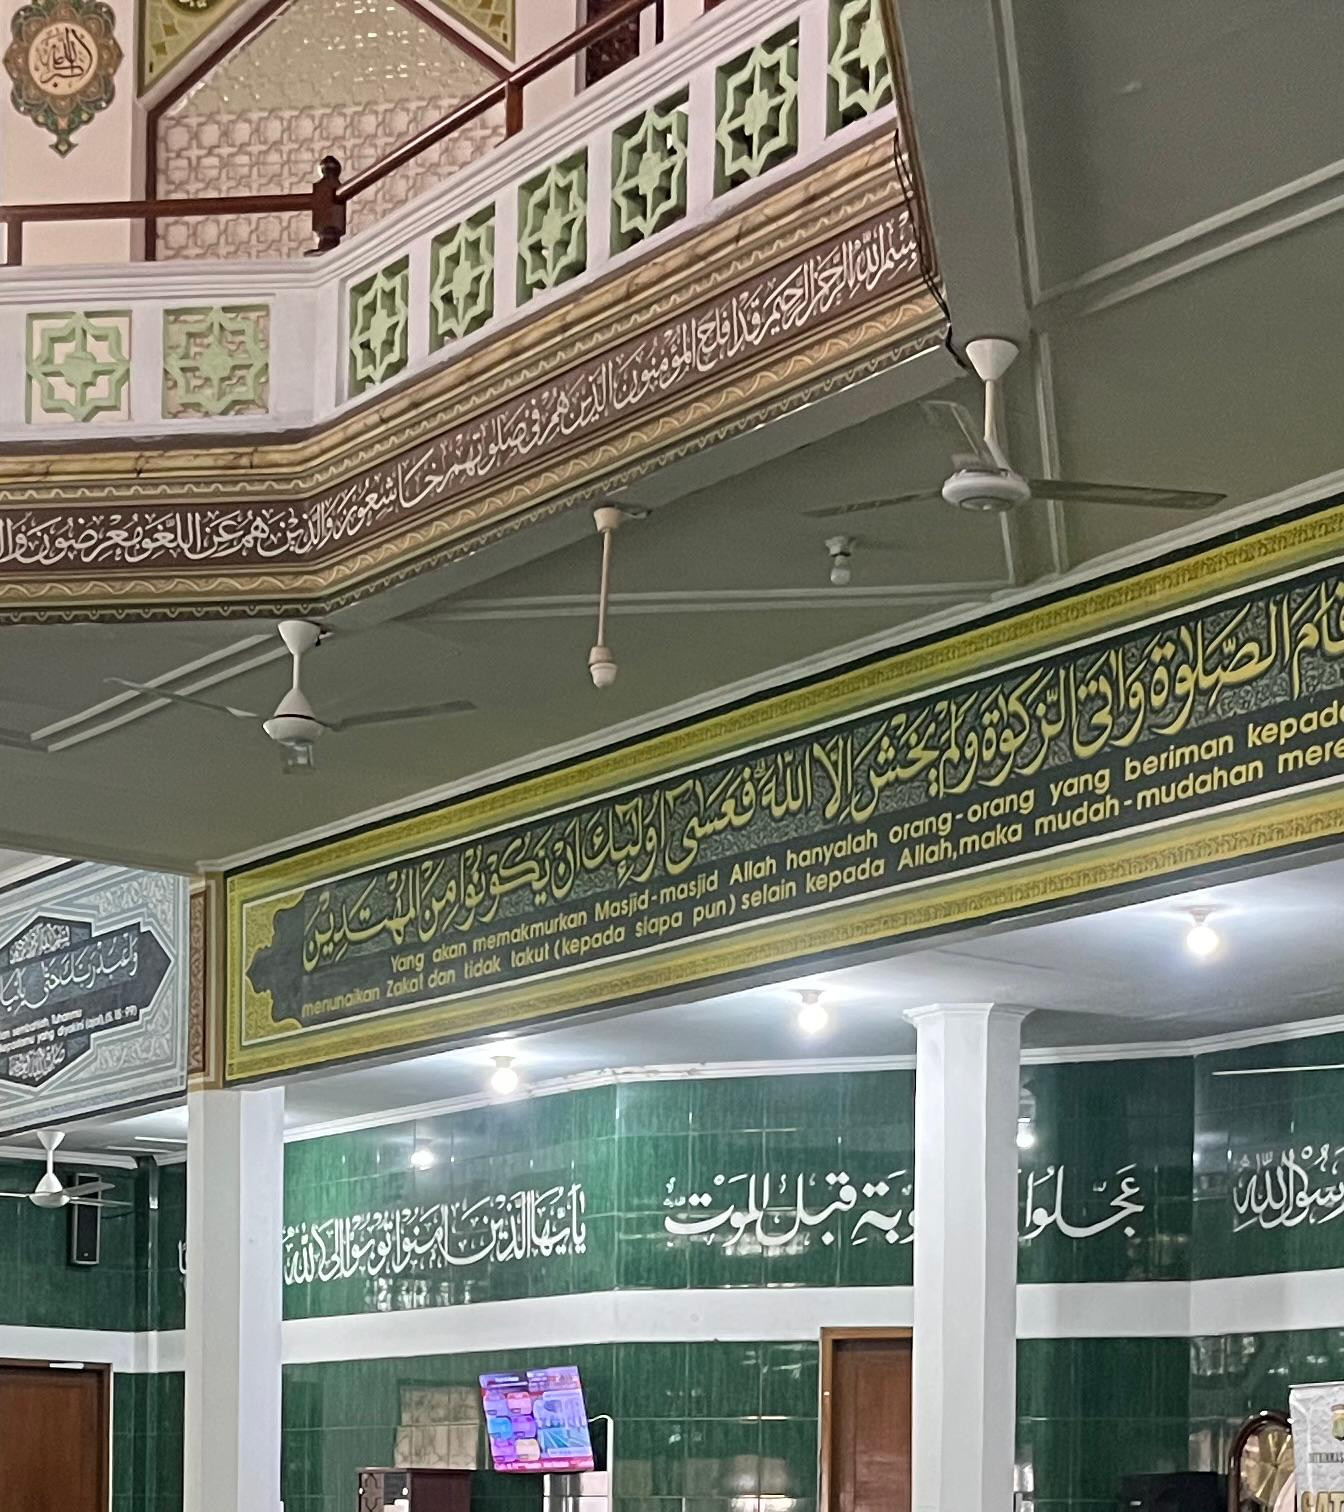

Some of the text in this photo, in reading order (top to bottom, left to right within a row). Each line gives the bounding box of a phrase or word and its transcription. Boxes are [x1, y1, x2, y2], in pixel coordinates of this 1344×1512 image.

[300, 985, 381, 1018] menunaikan
[386, 973, 425, 999] Zakat
[428, 967, 457, 991] dan
[463, 957, 502, 981] tidak
[510, 944, 551, 970] takut
[554, 925, 626, 962] (kepada
[634, 908, 683, 939] siapa
[692, 893, 737, 926] pun)
[740, 879, 798, 911] selain
[805, 856, 886, 896] kepada
[1033, 757, 1264, 837] mudah-mudahan
[390, 951, 425, 975] Yang
[432, 941, 468, 963] akan
[472, 908, 588, 951] memakmurkan
[594, 869, 720, 923] Masjid-masjid
[729, 854, 777, 886] Allah
[785, 828, 879, 870] hanyalah
[888, 787, 1036, 846] orang-orang
[1049, 764, 1111, 808] yang
[1124, 737, 1235, 782] beriman
